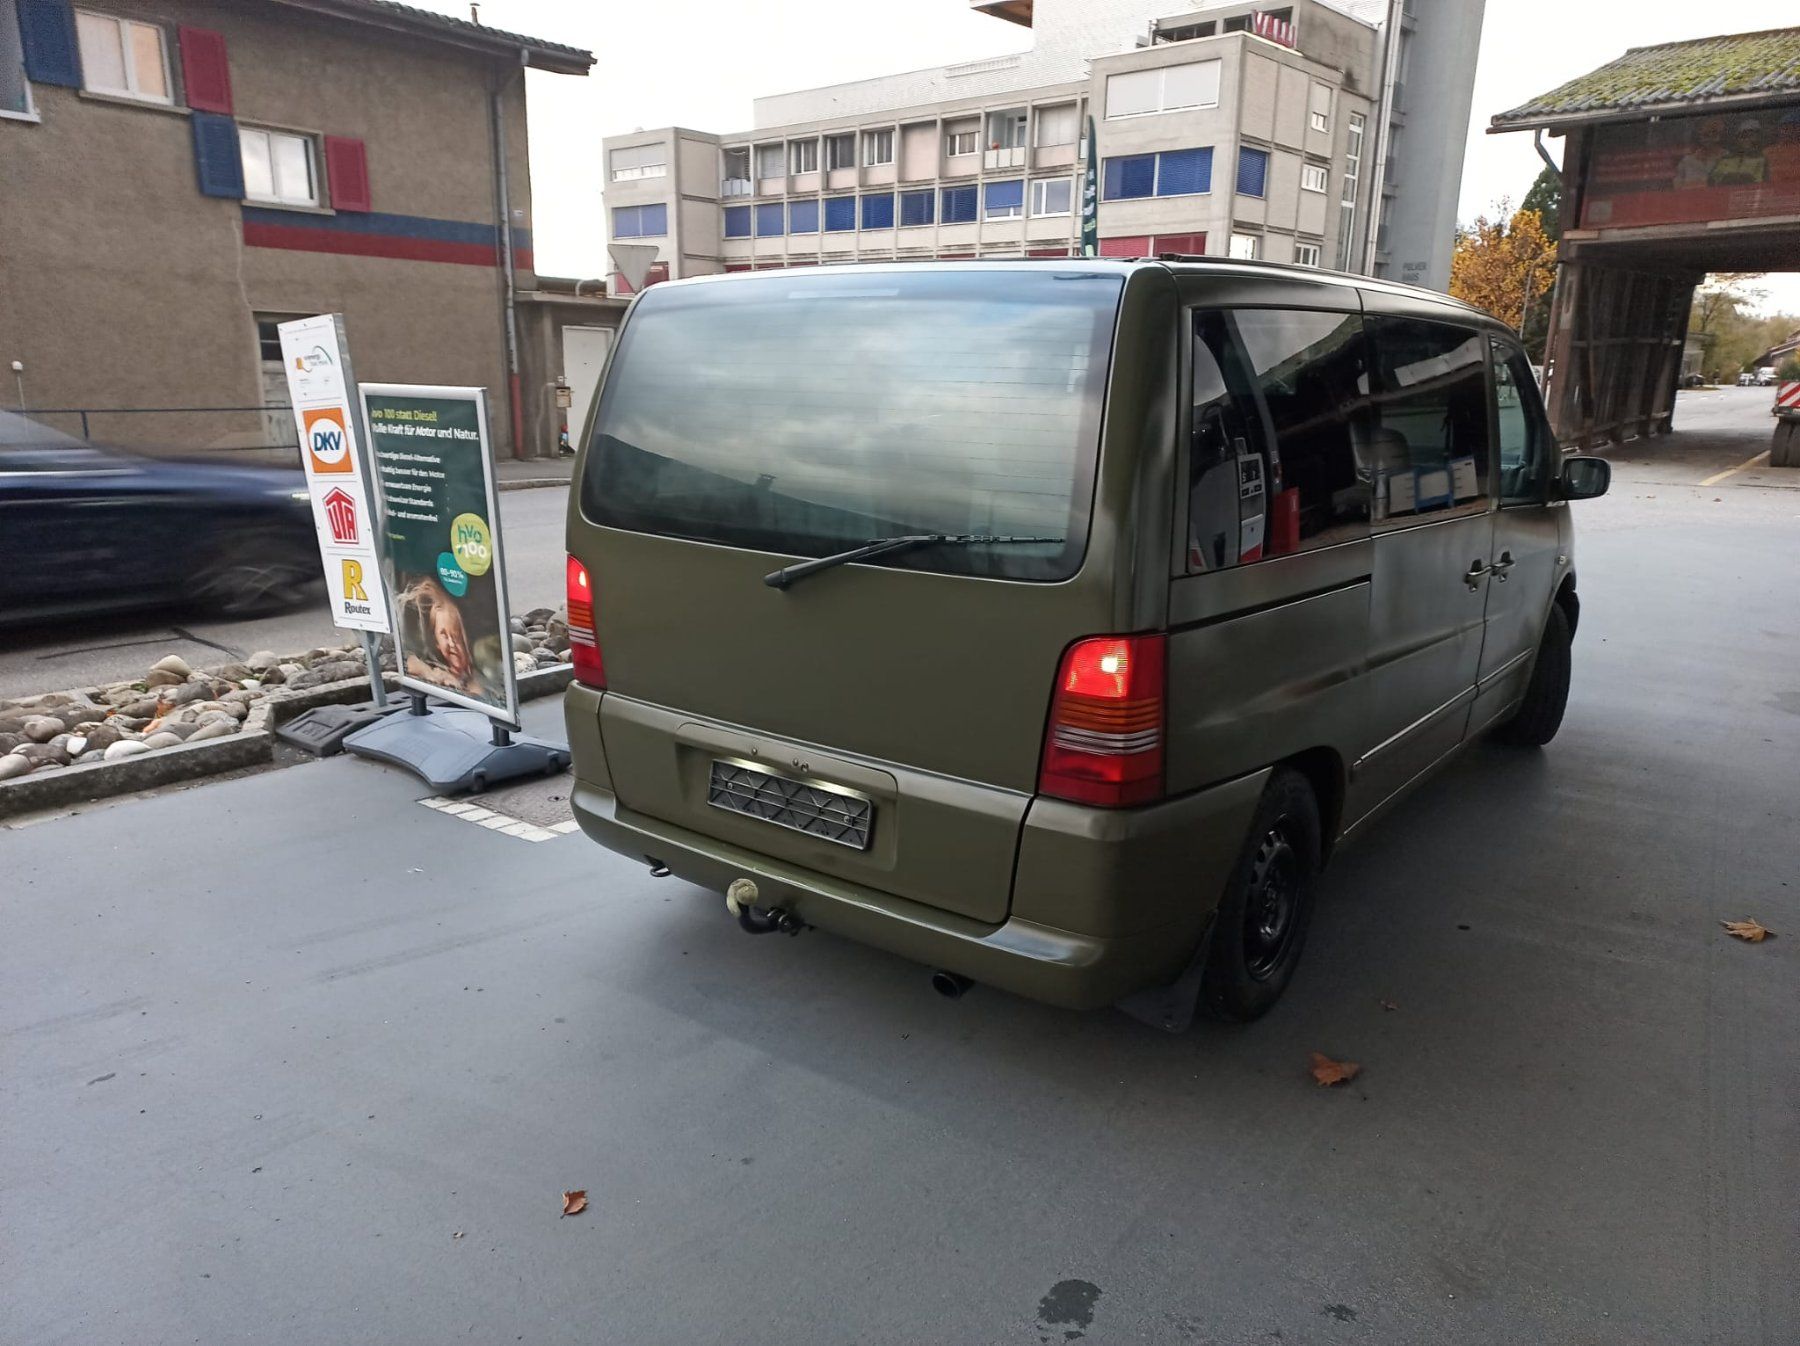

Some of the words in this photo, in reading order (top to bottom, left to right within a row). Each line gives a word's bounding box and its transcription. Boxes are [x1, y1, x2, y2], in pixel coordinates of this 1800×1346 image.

[313, 431, 341, 452] DKV
[388, 424, 404, 435] Kraft
[404, 425, 416, 436] für
[416, 426, 436, 437] Motor
[437, 427, 452, 439] und
[454, 428, 479, 440] Natur.
[325, 490, 357, 540] UTA
[457, 524, 482, 543] hvo
[341, 559, 369, 601] R
[344, 602, 371, 615] Routex
